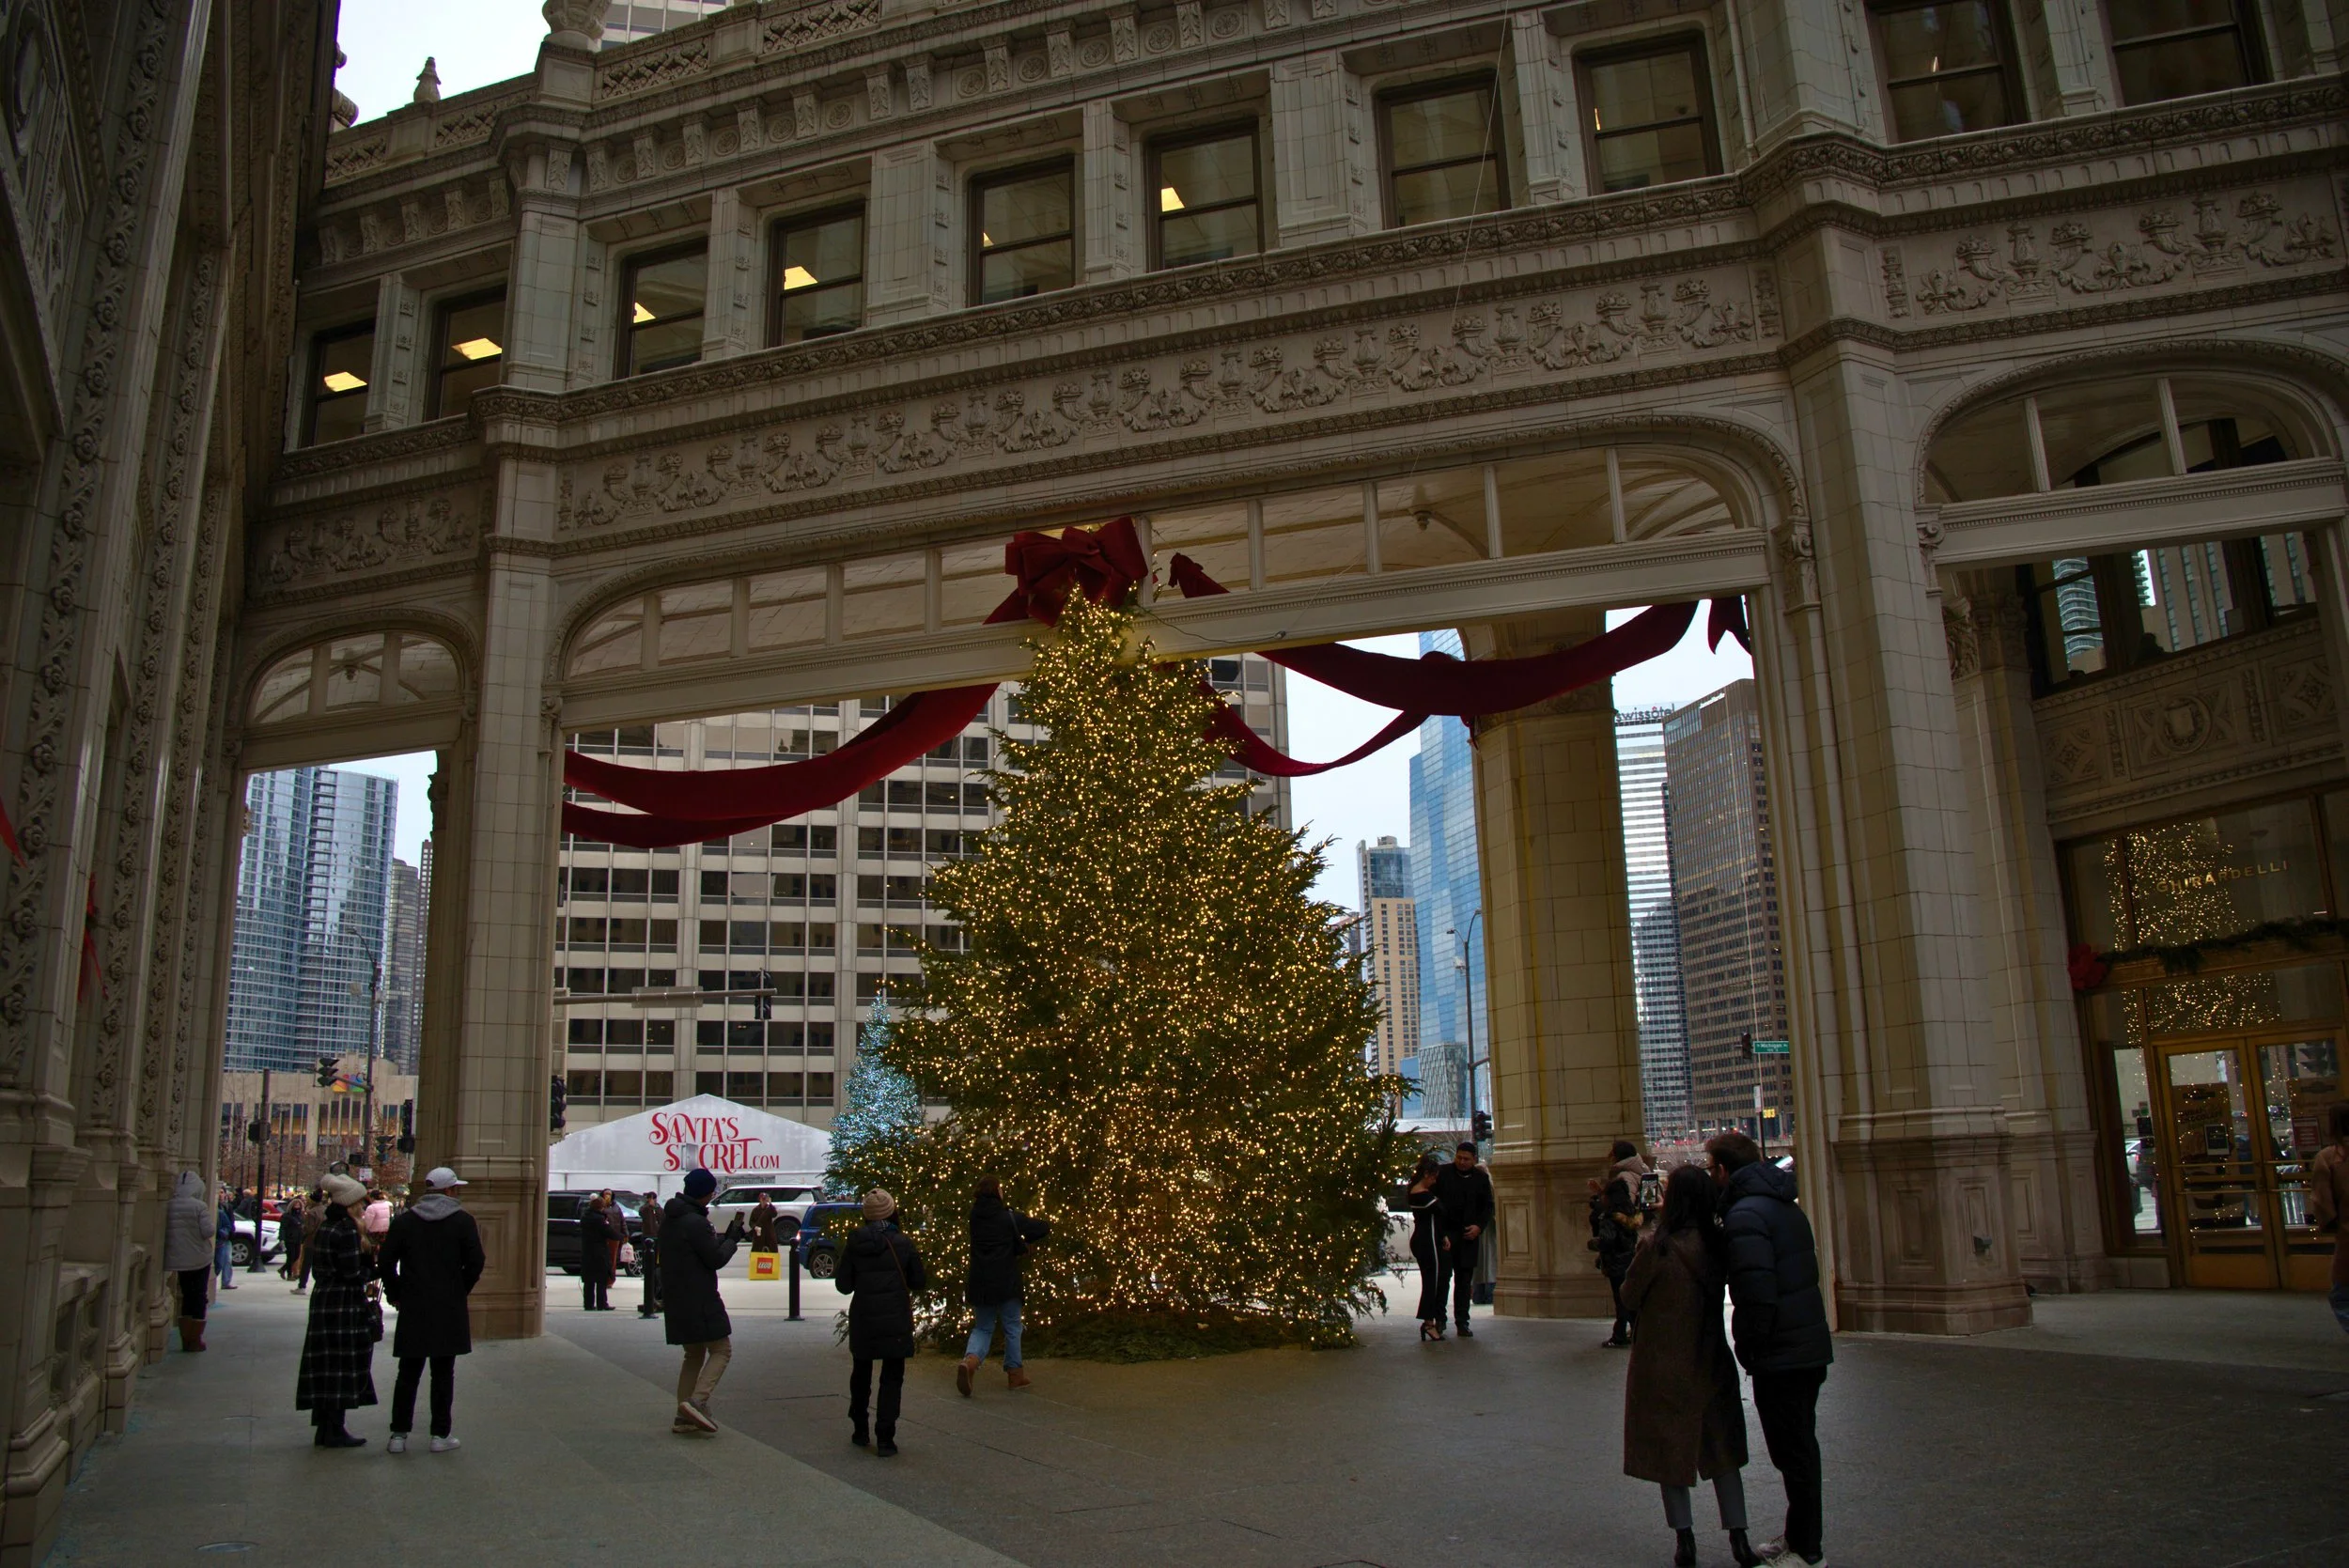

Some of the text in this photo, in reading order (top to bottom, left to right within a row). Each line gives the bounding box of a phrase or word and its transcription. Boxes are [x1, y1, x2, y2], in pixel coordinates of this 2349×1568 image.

[1615, 703, 1675, 722] swissôtel
[2156, 860, 2288, 893] GHIRARDELLI
[648, 1112, 740, 1145] SANTA'S
[663, 1138, 780, 1174] SCRET.COM
